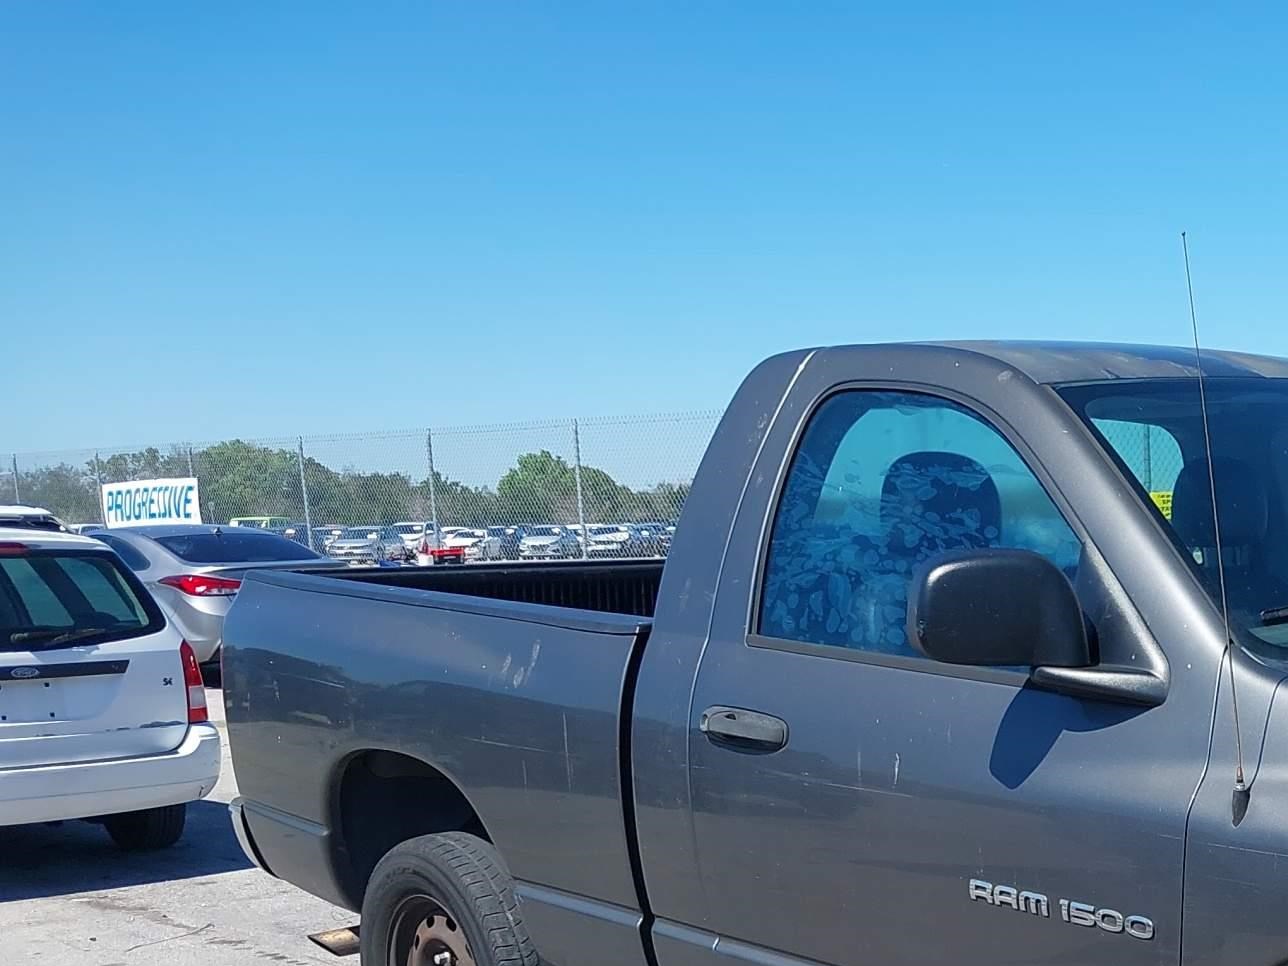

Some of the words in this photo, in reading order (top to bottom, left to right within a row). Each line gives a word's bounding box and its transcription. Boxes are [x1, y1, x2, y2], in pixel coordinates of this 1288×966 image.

[107, 485, 194, 522] PROGRESSIVE
[969, 878, 1050, 918] RAM
[1059, 898, 1155, 940] 1500
